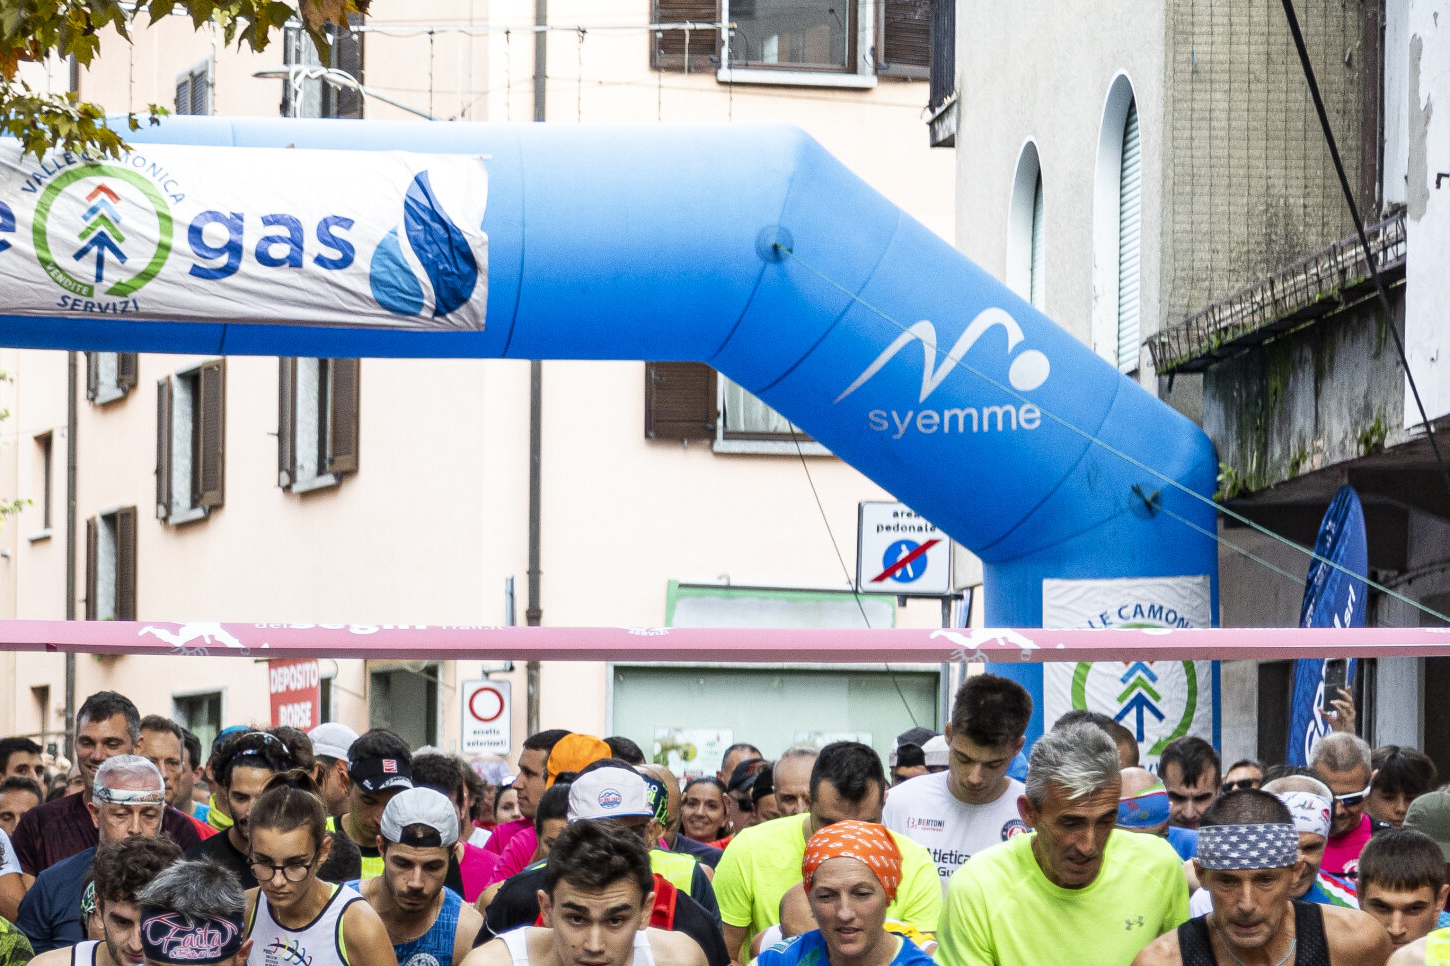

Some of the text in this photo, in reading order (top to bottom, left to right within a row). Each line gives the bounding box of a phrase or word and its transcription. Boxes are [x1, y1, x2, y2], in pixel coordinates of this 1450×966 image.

[187, 210, 356, 281] gas
[57, 294, 140, 314] SERVIZI
[867, 402, 1042, 440] syemme
[892, 510, 921, 519] area
[876, 522, 937, 534] pedonale
[269, 660, 319, 694] DEPOSITO
[278, 701, 313, 729] BORSE
[917, 818, 945, 828] BERTONI
